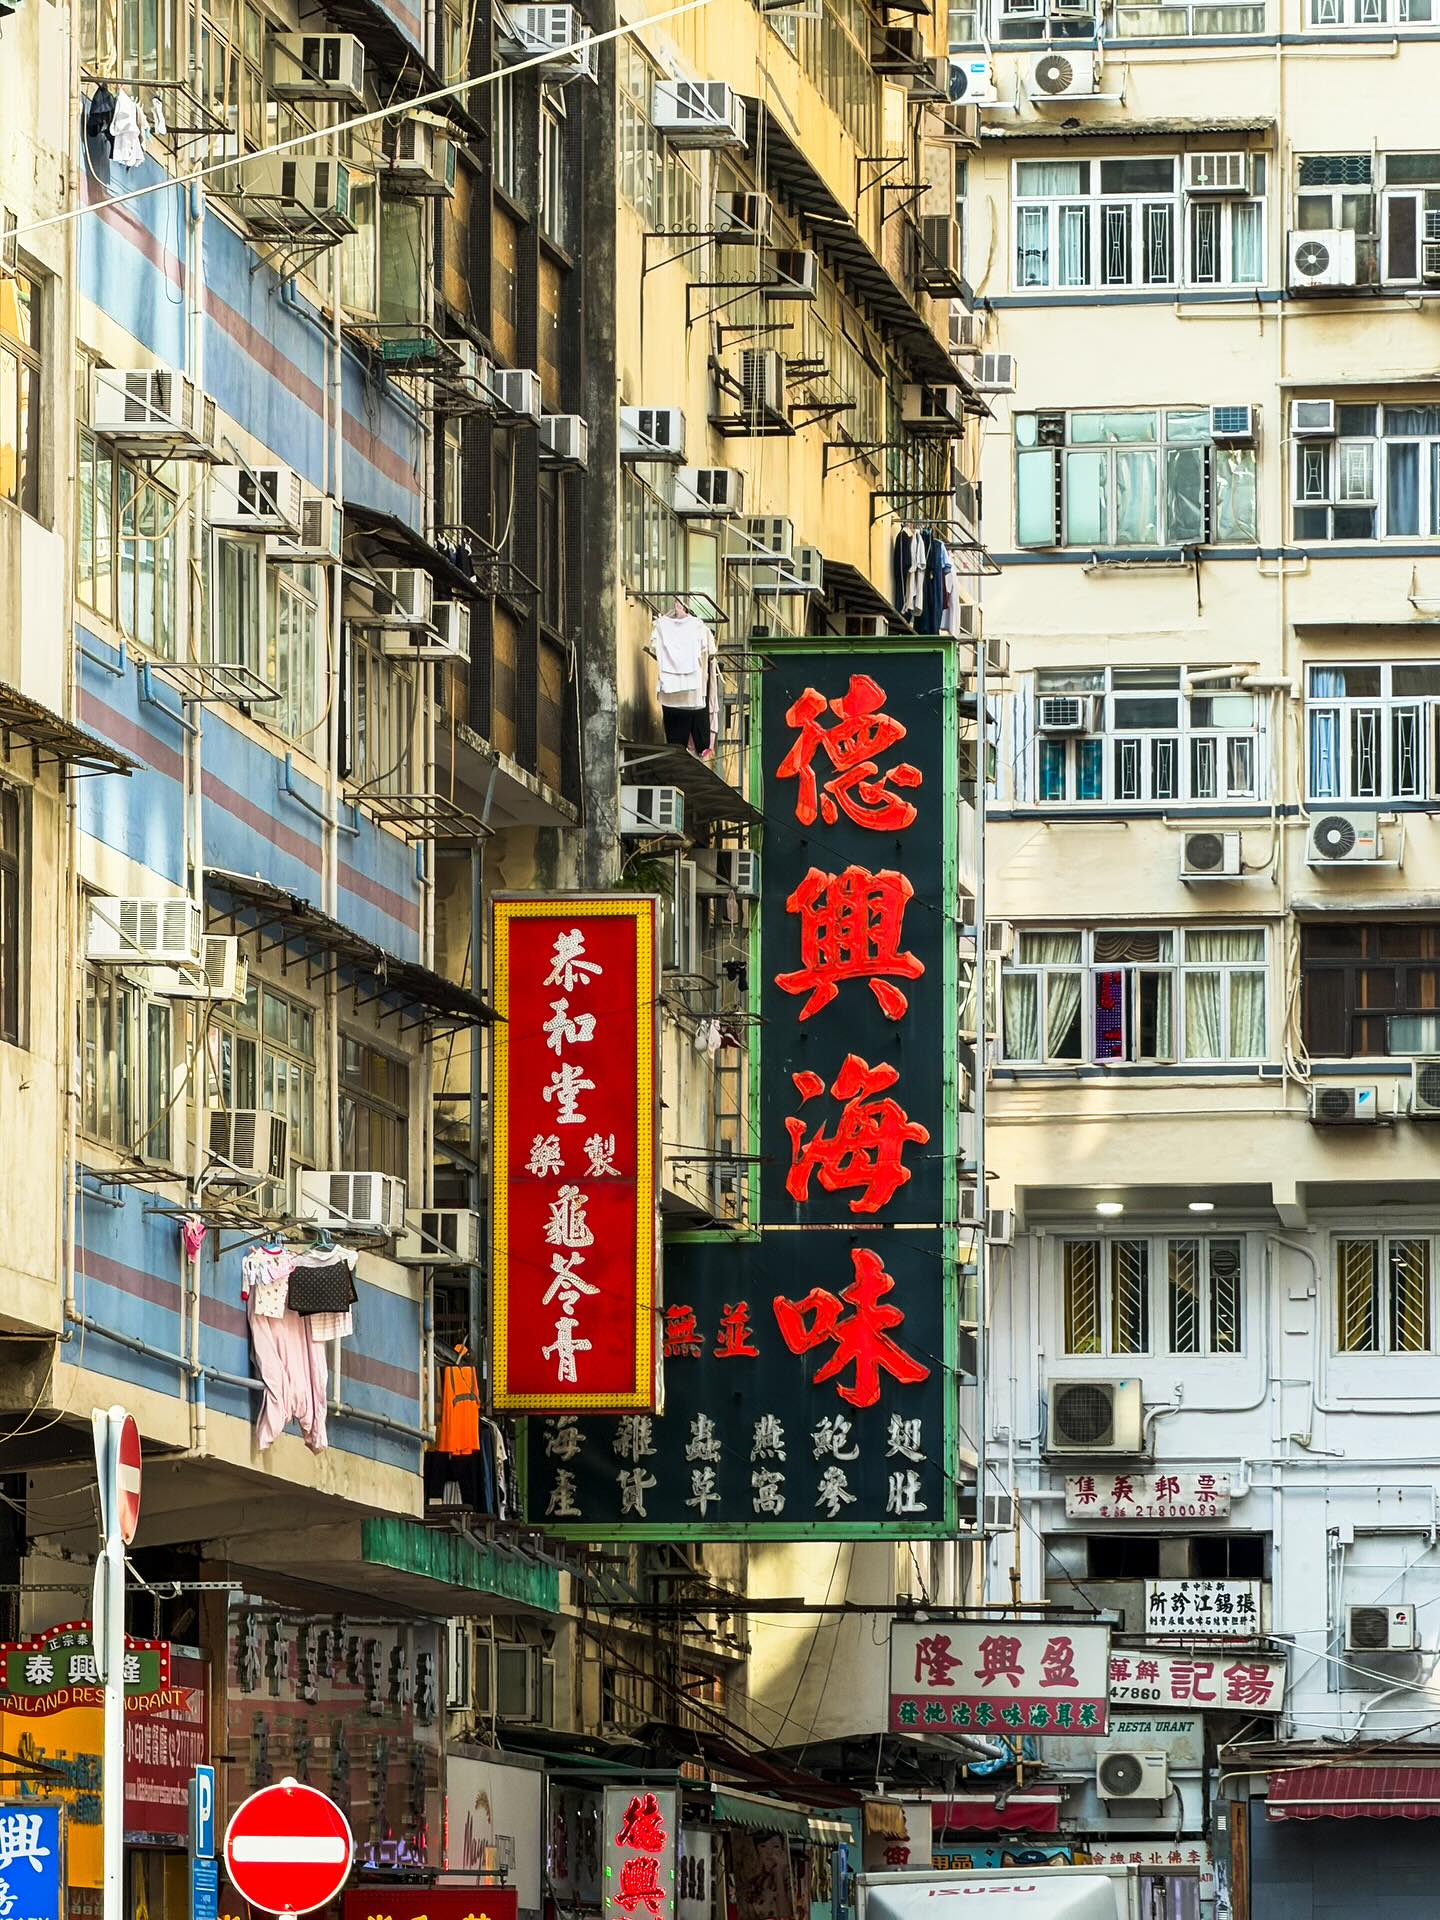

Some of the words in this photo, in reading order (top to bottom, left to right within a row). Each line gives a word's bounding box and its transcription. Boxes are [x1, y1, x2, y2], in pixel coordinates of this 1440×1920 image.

[543, 928, 603, 1124] 恭和堂
[773, 674, 929, 1408] 德興海味
[542, 1184, 601, 1382] 龜苓膏
[1136, 1505, 1216, 1517] 27800089
[199, 1775, 211, 1848] P
[929, 1885, 1036, 1897] ISUZU
